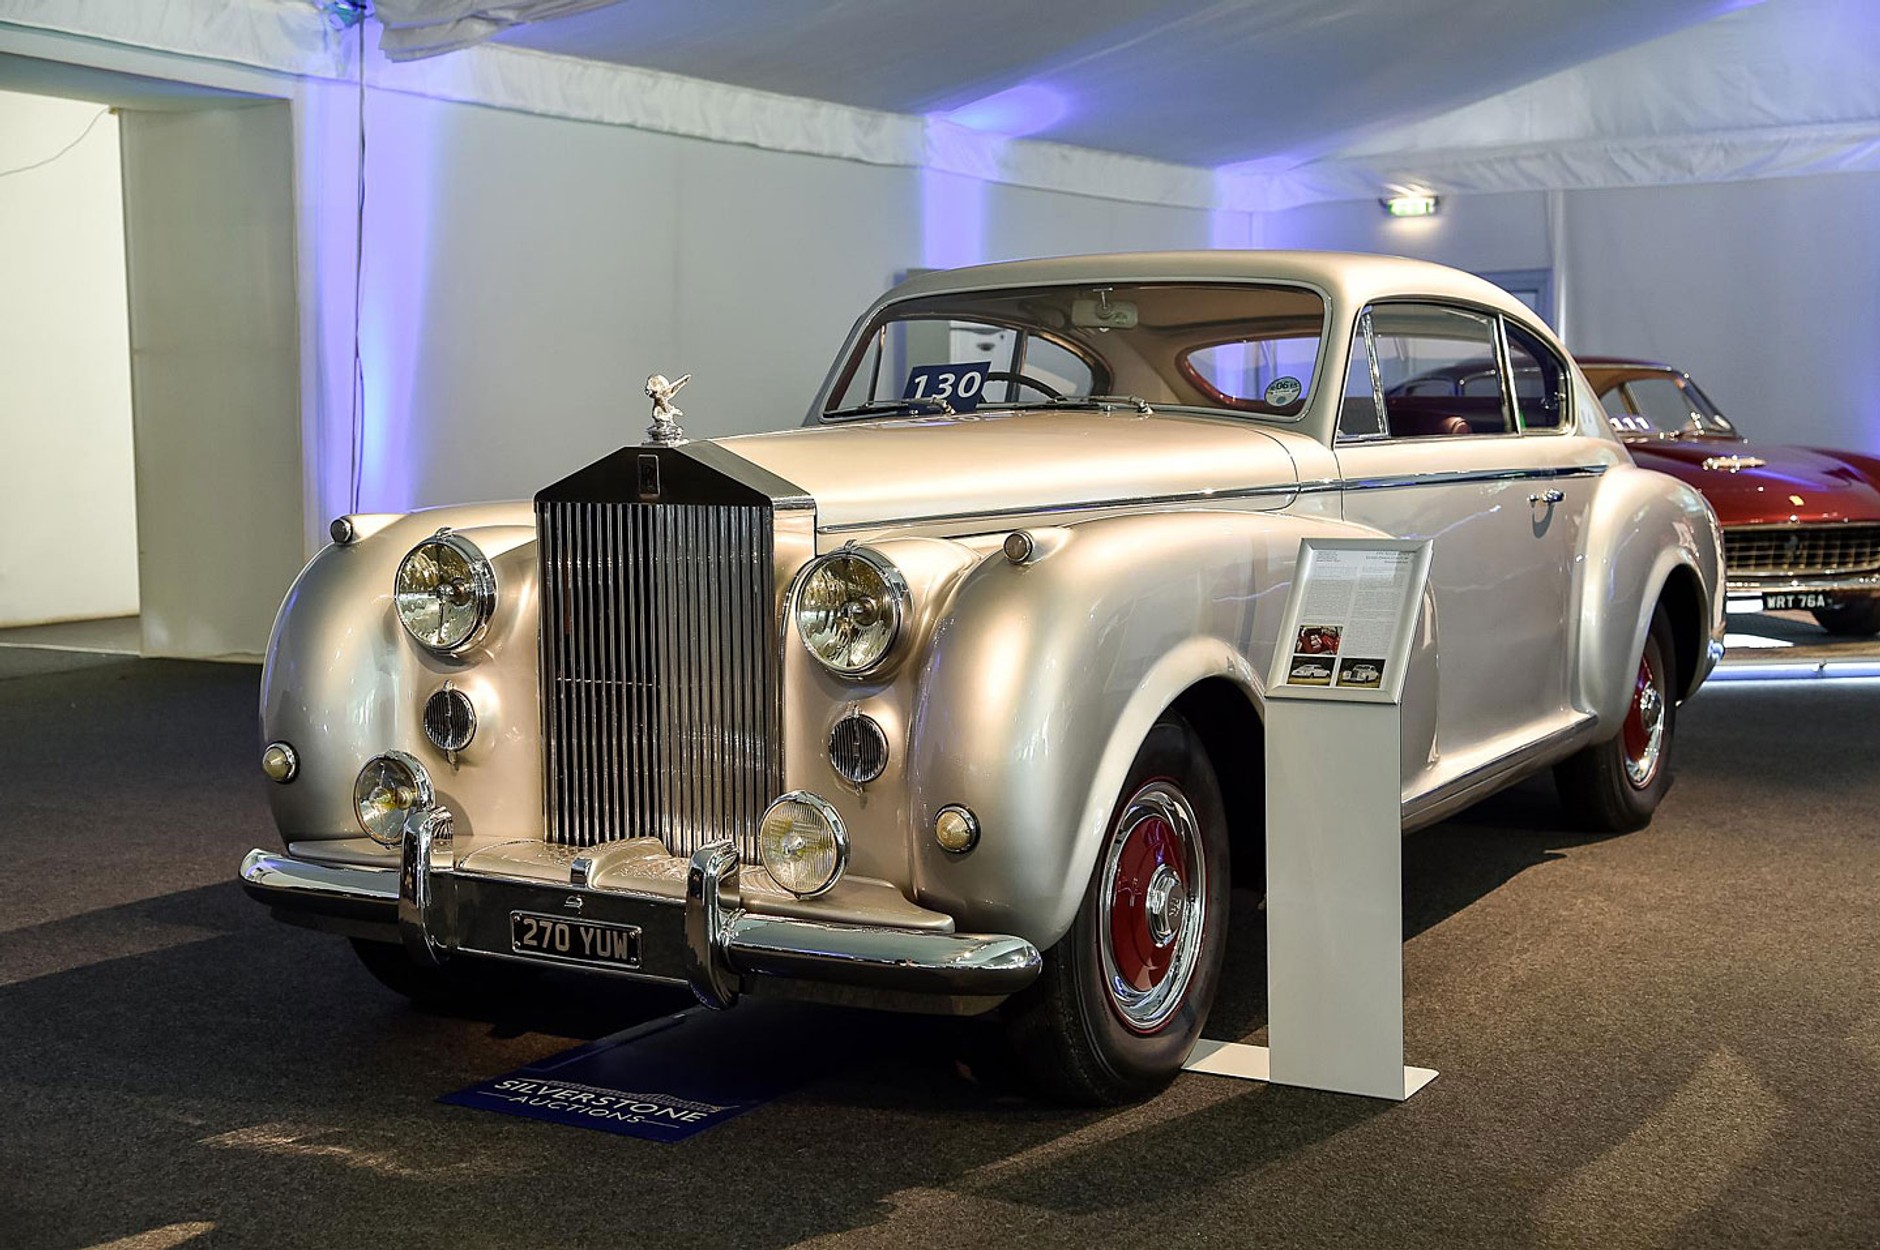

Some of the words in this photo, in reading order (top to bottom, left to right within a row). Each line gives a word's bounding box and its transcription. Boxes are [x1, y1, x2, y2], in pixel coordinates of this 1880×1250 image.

[914, 371, 982, 400] 130
[1766, 595, 1795, 609] WRT
[1798, 594, 1826, 608] 76A
[523, 918, 571, 952] 270
[579, 926, 628, 960] YUW
[494, 1080, 708, 1122] SILVERSTONE
[509, 1096, 645, 1124] AUCTIONS
